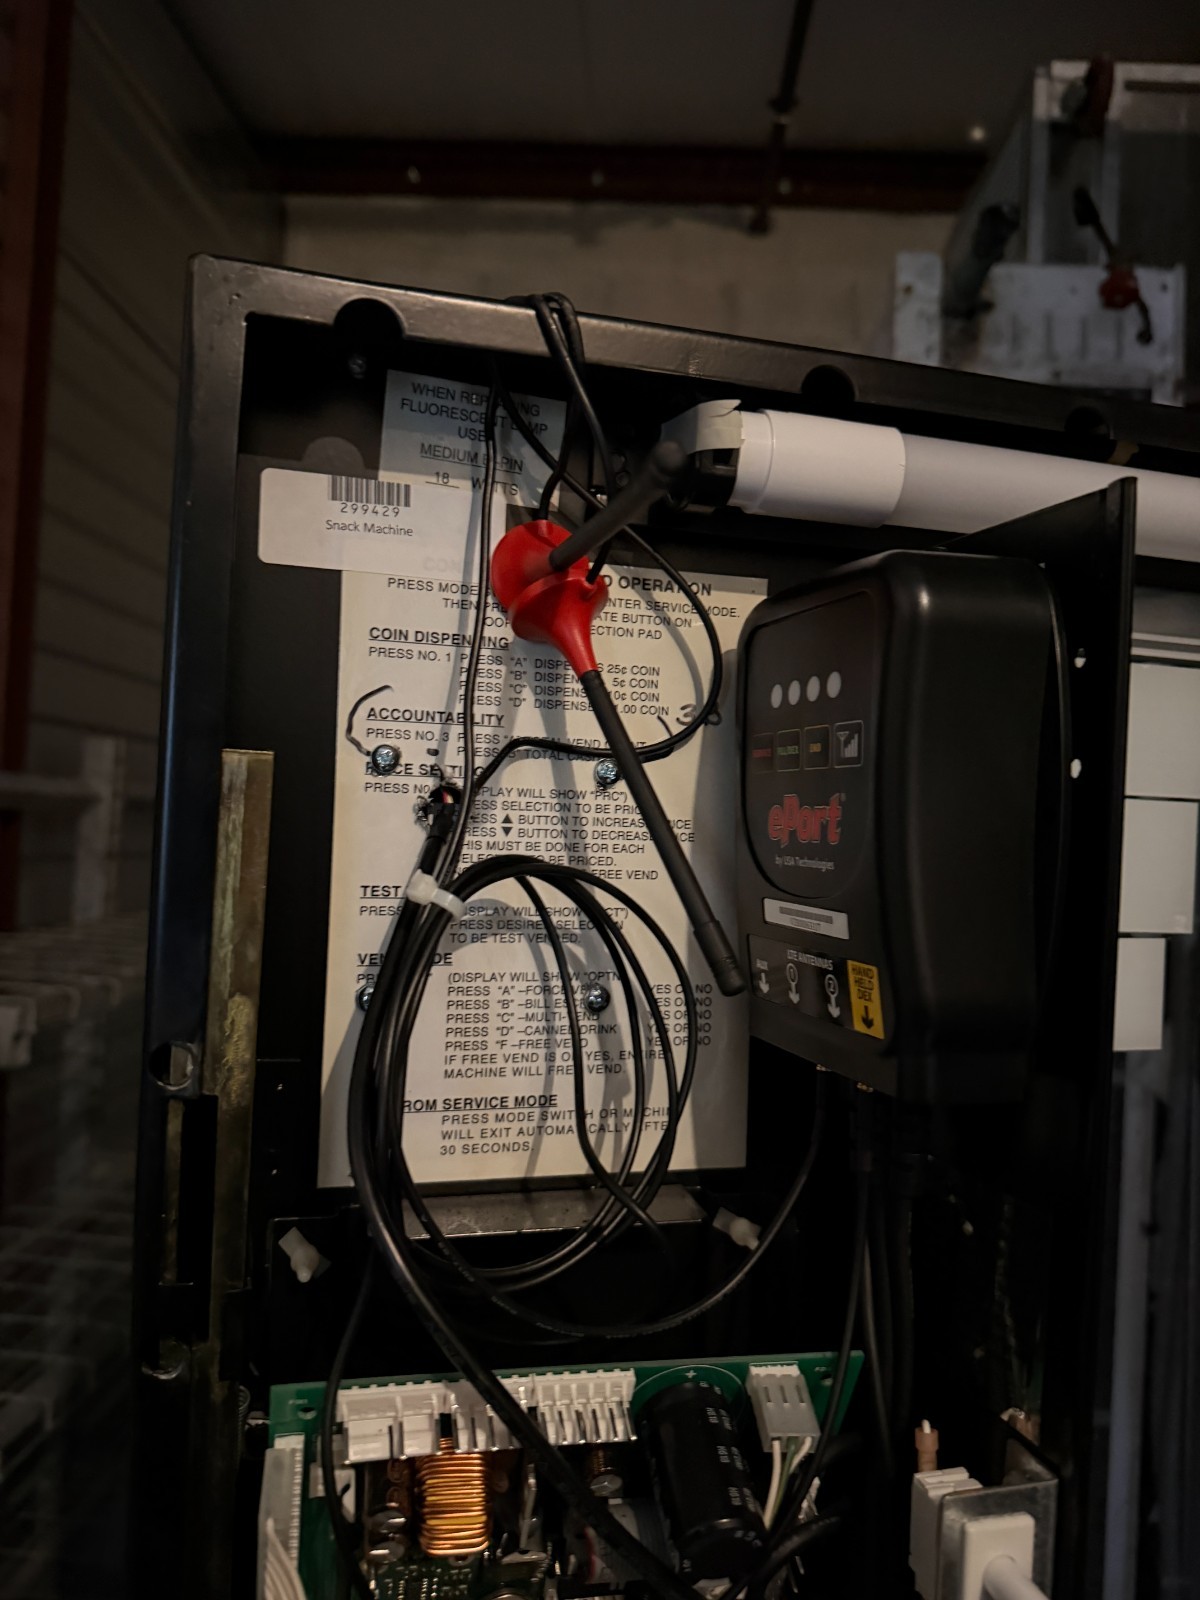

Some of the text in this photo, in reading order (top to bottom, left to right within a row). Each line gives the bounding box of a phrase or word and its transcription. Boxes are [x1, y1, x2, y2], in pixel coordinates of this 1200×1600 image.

[412, 382, 540, 416] WHEN REPING
[458, 427, 486, 442] USE
[420, 443, 478, 466] MEDIUM
[435, 471, 518, 496] 18 WTTS
[340, 502, 400, 517] 299429
[325, 520, 413, 537] Snack Machine
[388, 578, 479, 596] PRESS MODE
[442, 598, 479, 610] THEN
[606, 596, 641, 610] NTER
[645, 600, 700, 615] SERVICE
[622, 612, 671, 626] BUTTON
[674, 618, 692, 628] ON
[369, 626, 509, 649] COIN DISPENING
[638, 630, 662, 640] PAD
[368, 646, 414, 660] PRESS
[418, 650, 441, 661] NO.
[446, 650, 451, 662] 1
[461, 654, 502, 666] PESS
[631, 666, 660, 676] COIN
[460, 667, 502, 679] PESS
[629, 678, 659, 690] COIN
[460, 680, 502, 693] PESS
[630, 692, 660, 702] COIN
[459, 694, 502, 706] PESS
[640, 704, 670, 716] COIN
[366, 707, 505, 726] ACCOUNTABLITY
[366, 728, 412, 740] PRESS
[415, 730, 438, 742] NO.
[442, 732, 450, 742] 3
[457, 732, 500, 744] PESS
[456, 747, 499, 758] PESS
[525, 750, 564, 760] TOTAL
[364, 782, 410, 794] PRESS
[516, 788, 546, 799] WILL
[549, 788, 587, 800] SHOW
[501, 801, 572, 813] SELECTION
[576, 804, 592, 814] TO
[596, 804, 612, 814] BE
[518, 815, 568, 826] BUTTON
[572, 816, 588, 826] TO
[592, 818, 645, 828] INCREAS
[768, 792, 842, 848] ePort
[466, 826, 497, 838] RESS
[518, 828, 568, 839] BUTTON
[572, 830, 588, 840] TO
[462, 840, 645, 854] HIS MUST BE DONE FOR EACH
[568, 856, 617, 867] PRICED.
[626, 870, 659, 880] VEND
[360, 885, 402, 897] TEST
[360, 906, 402, 916] PRESS
[497, 920, 543, 931] DESIRE
[450, 933, 580, 944] TO BE TEST VENED.
[448, 972, 581, 983] (DISPLAY WILL SHW
[448, 986, 490, 996] PRESS
[696, 984, 712, 994] NO
[446, 1000, 490, 1010] PRESS
[696, 996, 712, 1006] NO
[446, 1013, 490, 1024] PRESS
[445, 1027, 488, 1038] PRESS
[580, 1024, 618, 1034] DRINK
[445, 1040, 488, 1052] PRESS
[556, 1038, 588, 1049] VED
[444, 1054, 456, 1066] IF
[462, 1054, 498, 1064] FREE
[503, 1053, 540, 1063] VEND
[544, 1052, 556, 1062] IS
[620, 1050, 665, 1060] ENIRE
[444, 1067, 507, 1079] MACHINE
[512, 1066, 543, 1077] WILL
[548, 1064, 574, 1076] FRE
[442, 1097, 508, 1110] SERVICE
[514, 1094, 558, 1108] MODE
[442, 1108, 618, 1126] PRESS MODE SWITH OR
[441, 1121, 630, 1140] WILL EXIT AUTOMACALLY
[440, 1141, 534, 1156] 30 SECONDS.
